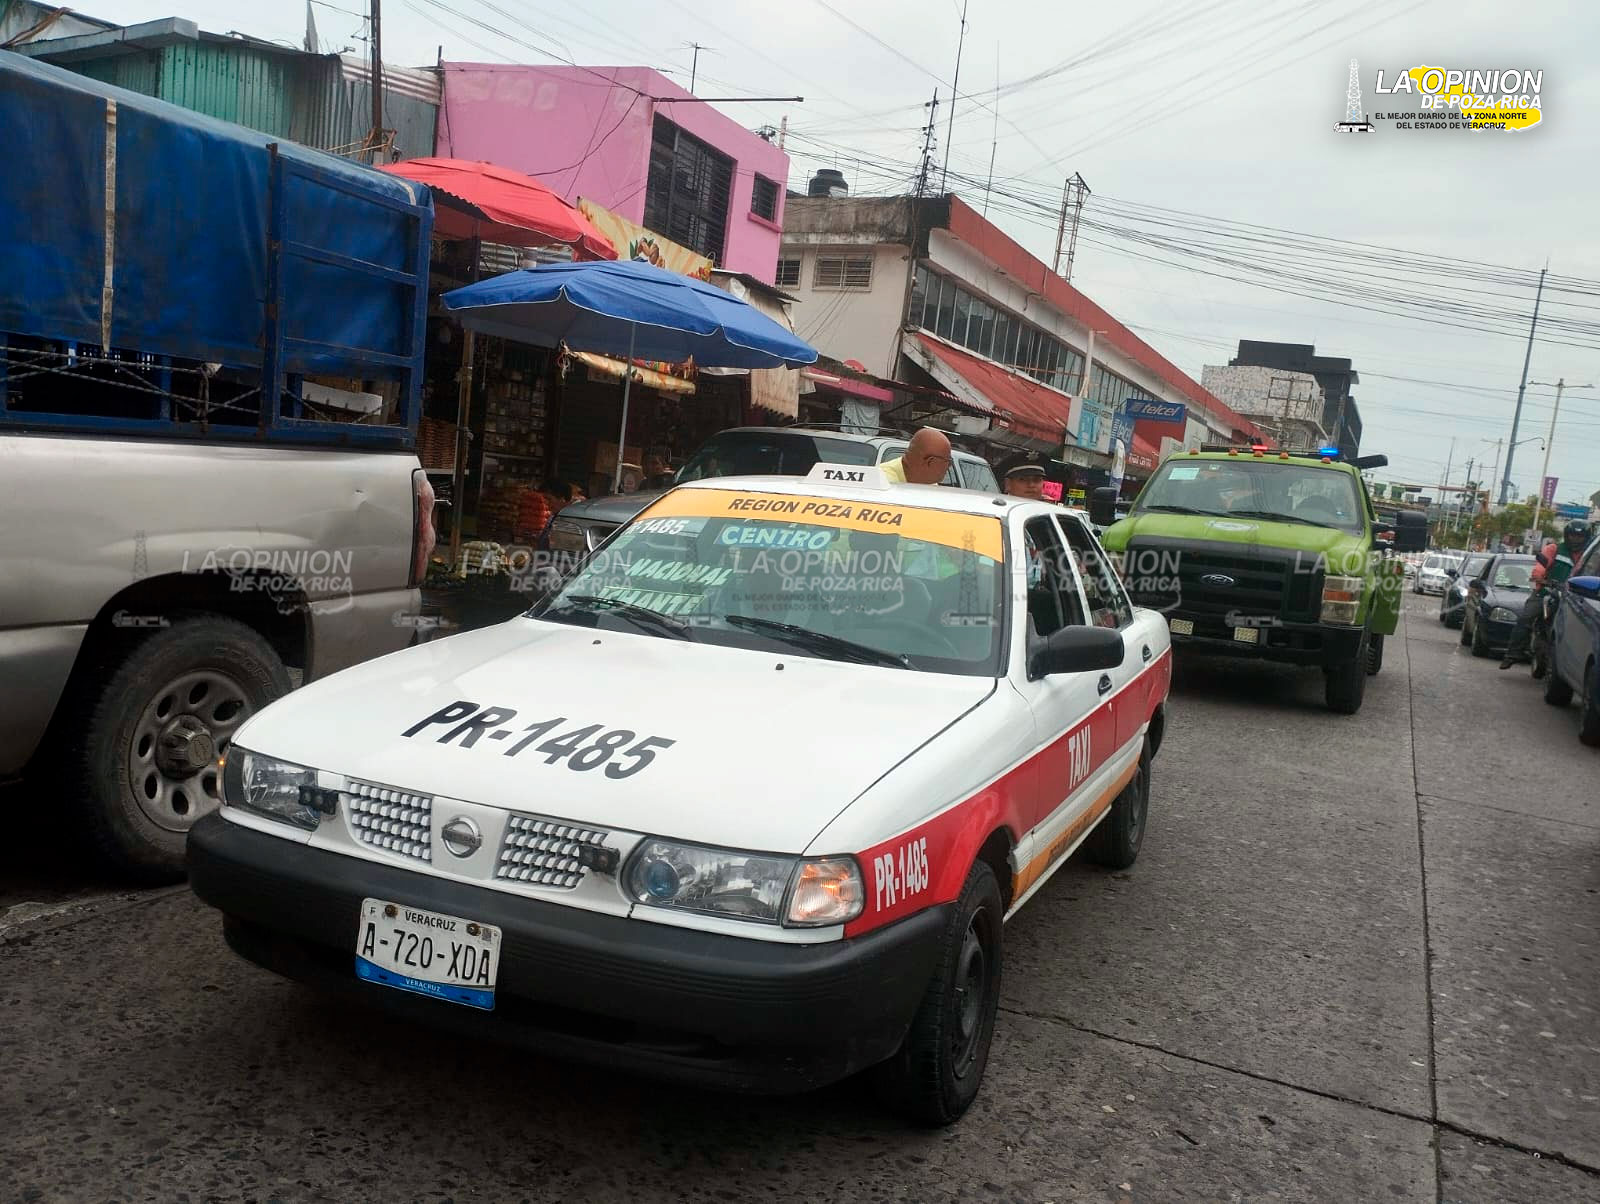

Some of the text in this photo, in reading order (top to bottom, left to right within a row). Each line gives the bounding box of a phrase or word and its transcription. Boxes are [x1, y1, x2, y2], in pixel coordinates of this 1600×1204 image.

[1142, 404, 1180, 416] telcel
[823, 469, 864, 482] TAXI
[728, 498, 903, 527] REGION POZA RICA
[721, 526, 832, 550] CENTRO
[625, 558, 733, 586] NACIONAL
[400, 700, 677, 779] PR-1485
[1068, 724, 1091, 790] TAXI
[874, 837, 929, 912] PR-1485
[405, 910, 457, 932] VERACRUZ
[362, 922, 490, 985] A-720-XDA
[405, 978, 441, 993] VERACRUZ
